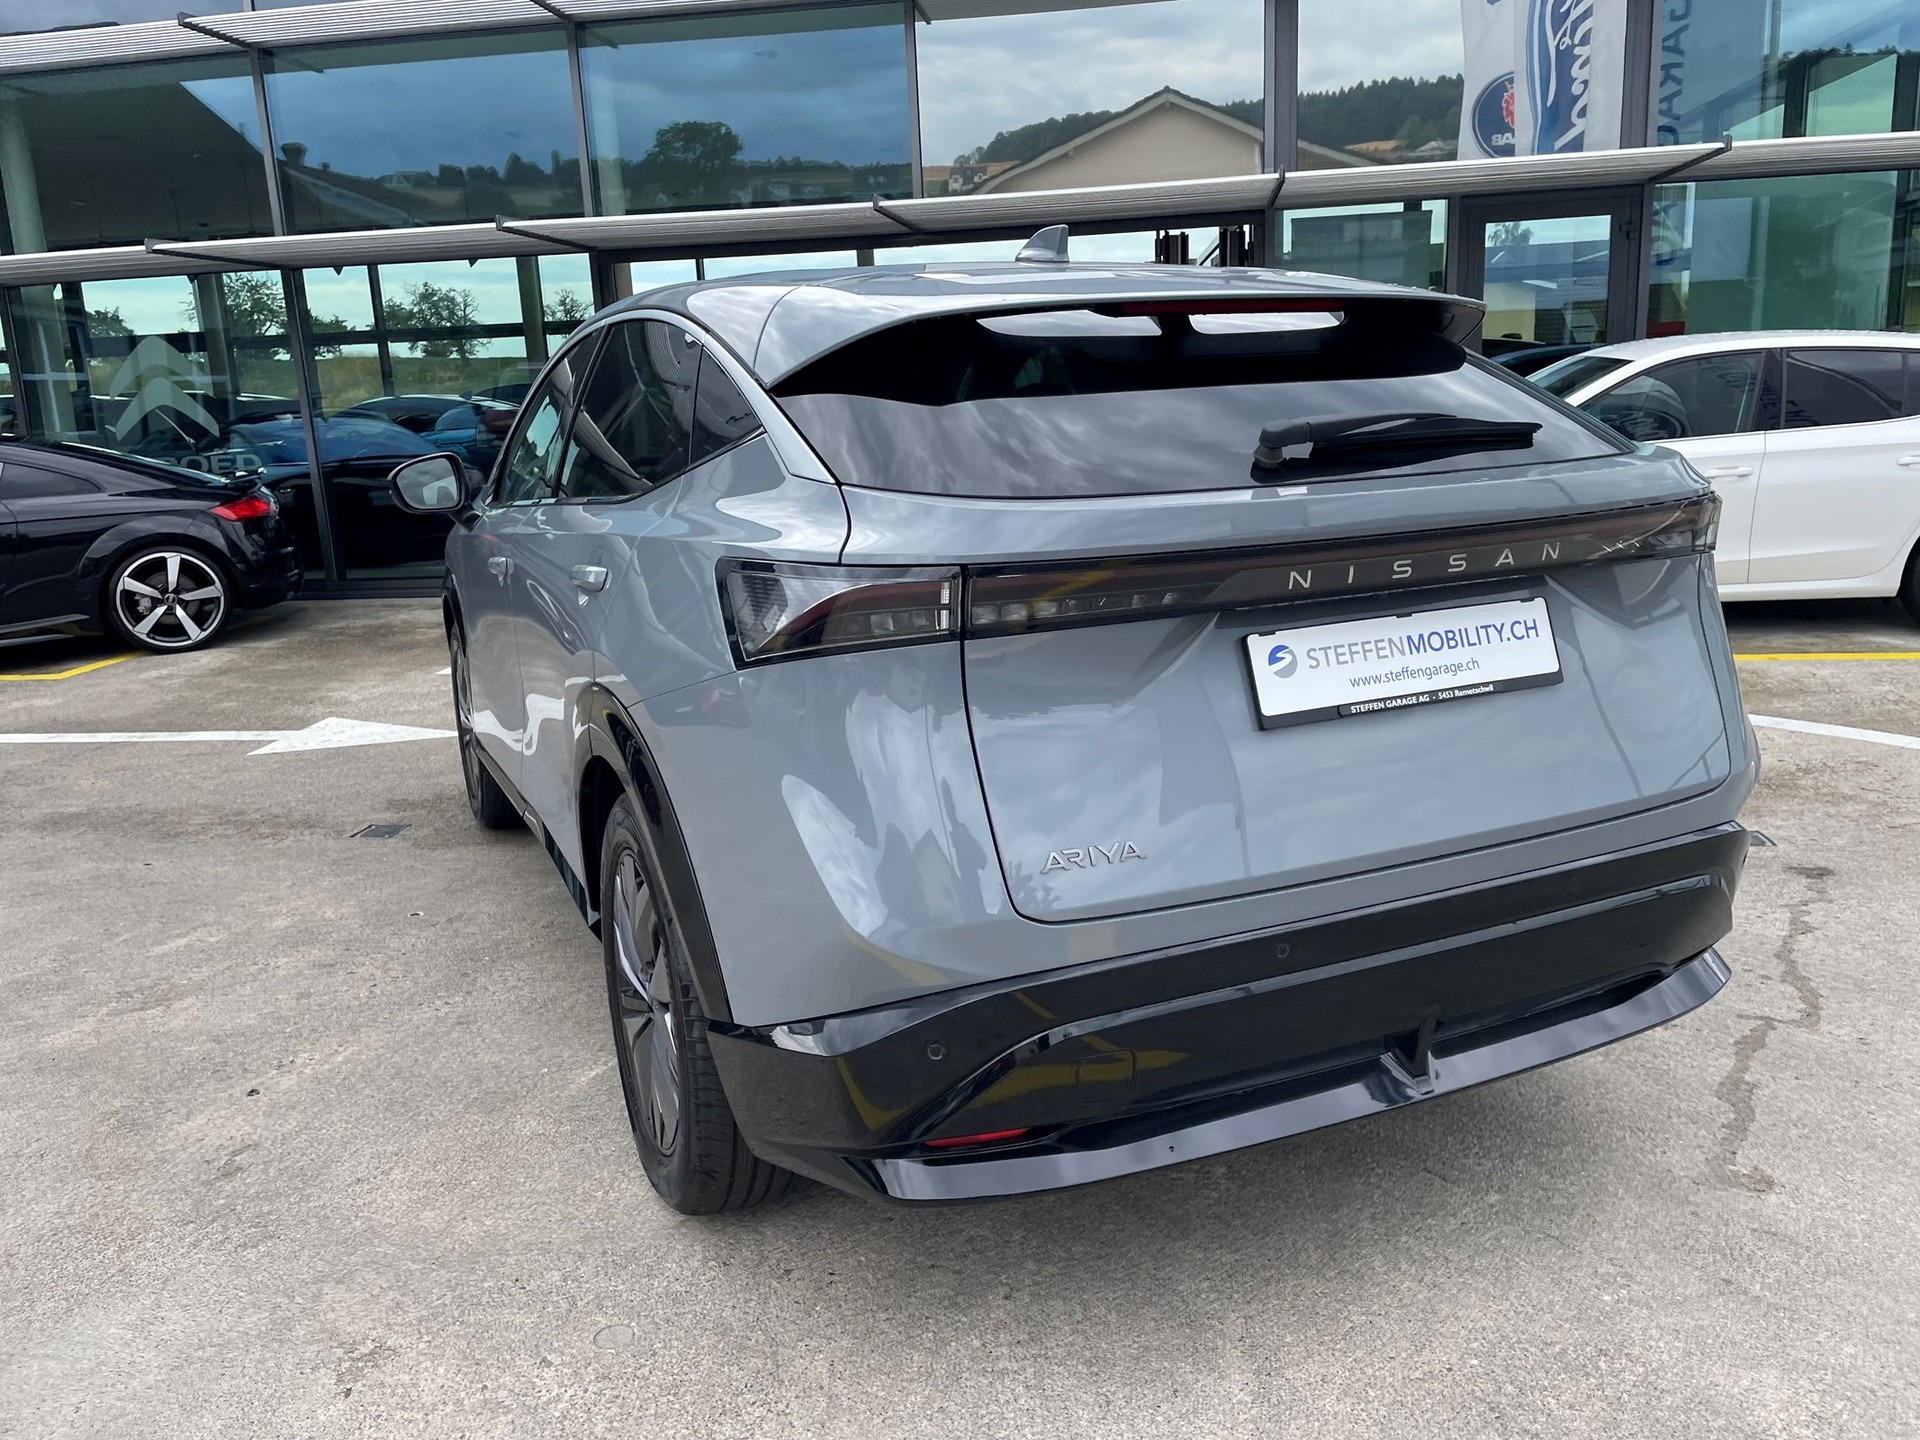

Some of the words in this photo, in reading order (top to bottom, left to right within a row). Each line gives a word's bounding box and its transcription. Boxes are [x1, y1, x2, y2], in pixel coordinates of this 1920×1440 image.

[1287, 541, 1561, 590] NISSAN
[1306, 618, 1540, 670] STEFFENMOBILITY.CH
[1349, 657, 1480, 688] www.steffengarage.ch
[1350, 701, 1385, 714] STEFFEN
[1386, 697, 1418, 708] GARAGE
[1418, 694, 1430, 703] AG
[1438, 689, 1454, 700] 5453
[1454, 684, 1495, 698] Remetschwil
[1040, 840, 1147, 875] ARIYA
